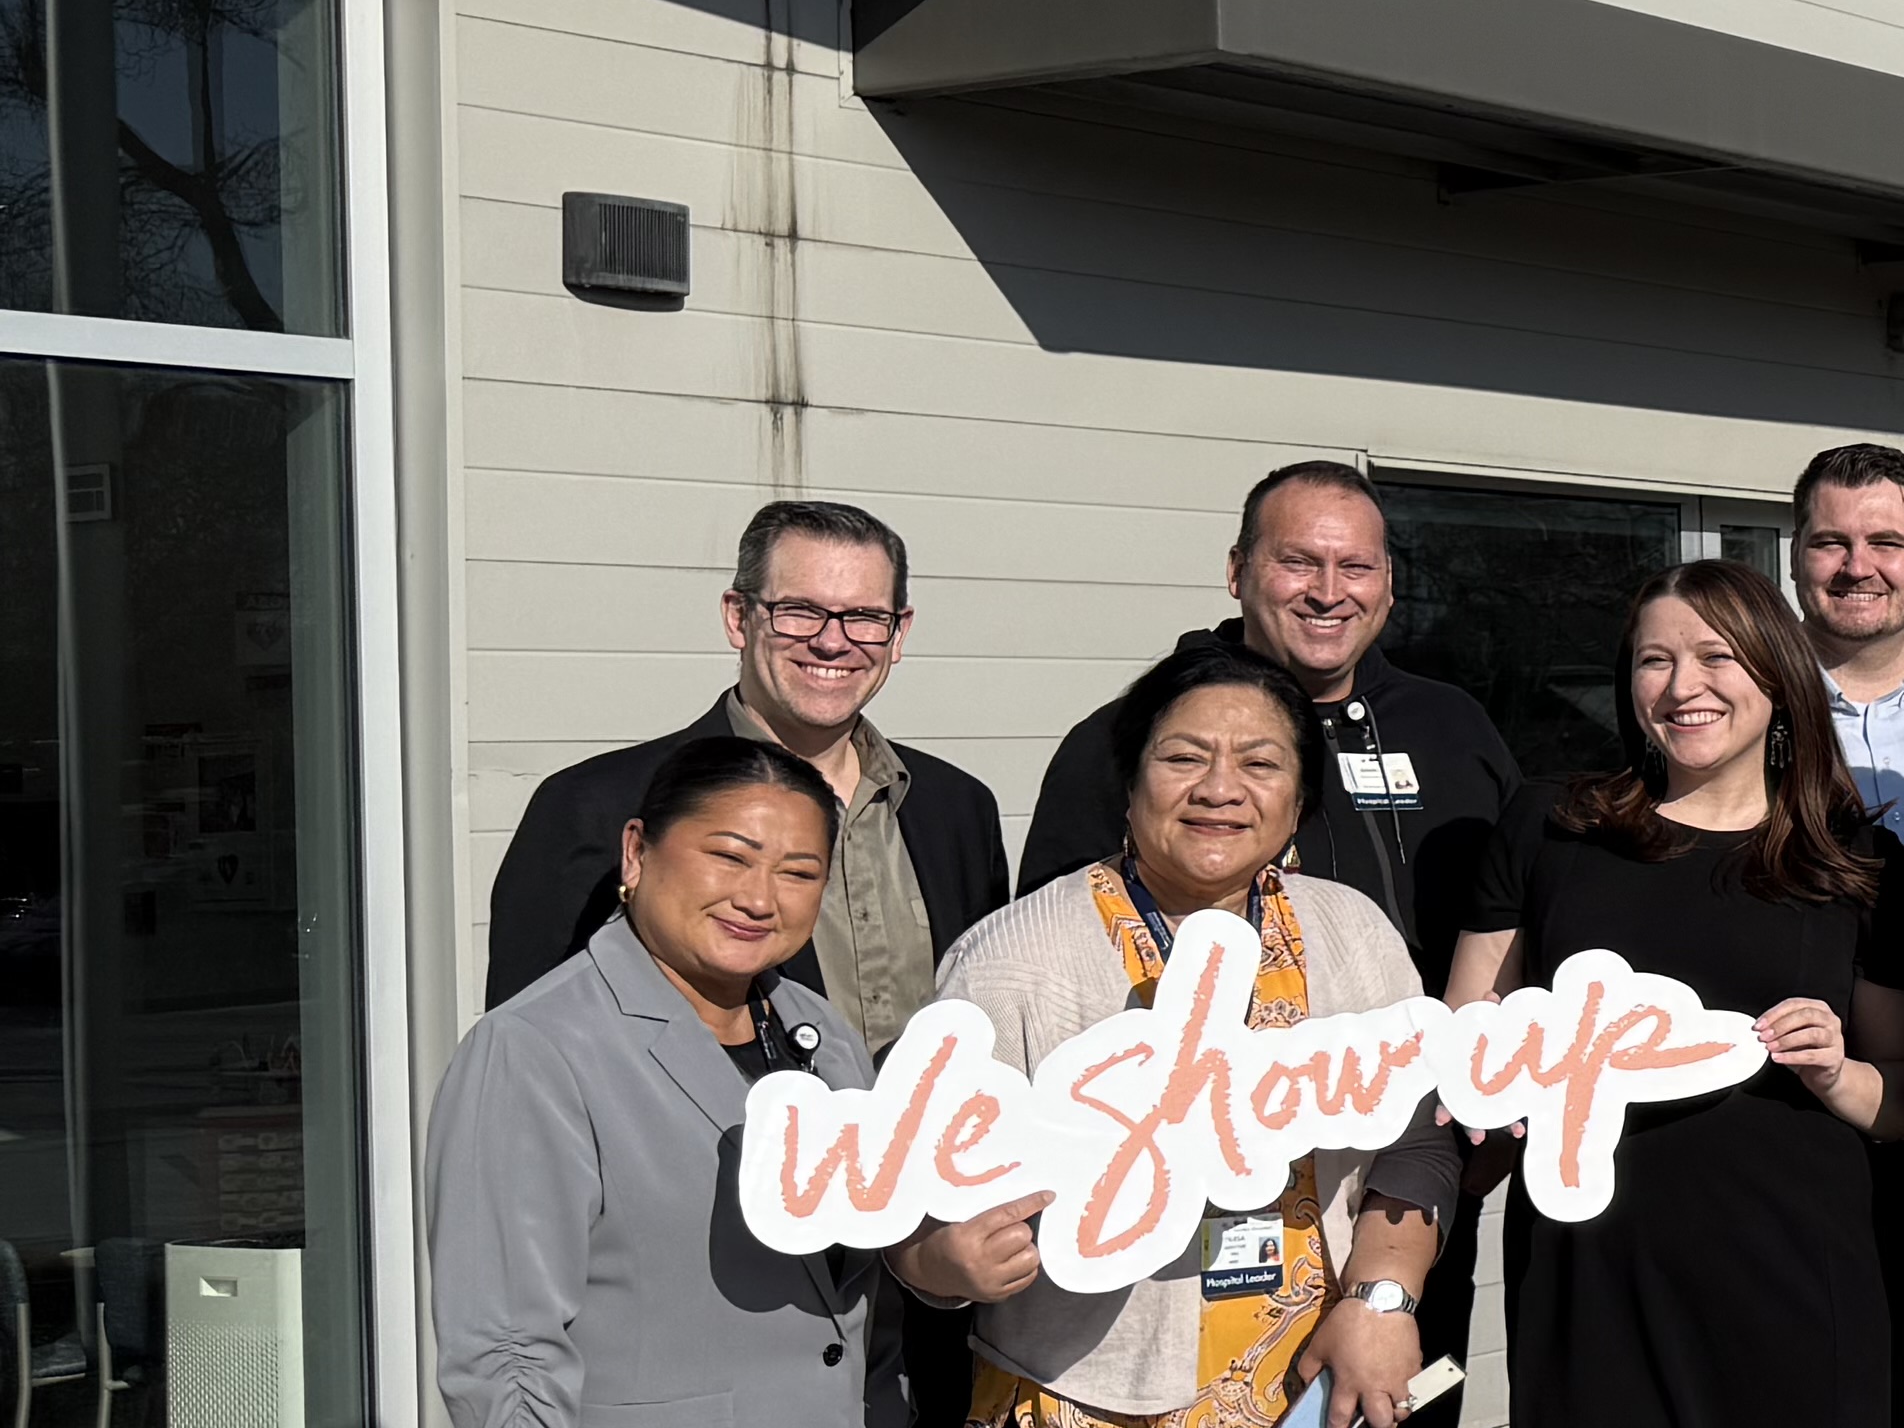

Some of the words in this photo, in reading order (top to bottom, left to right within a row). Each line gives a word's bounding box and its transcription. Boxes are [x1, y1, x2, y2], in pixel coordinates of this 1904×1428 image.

[1470, 980, 1737, 1189] up
[1206, 1273, 1244, 1289] Hospital
[1245, 1270, 1277, 1284] Leader
